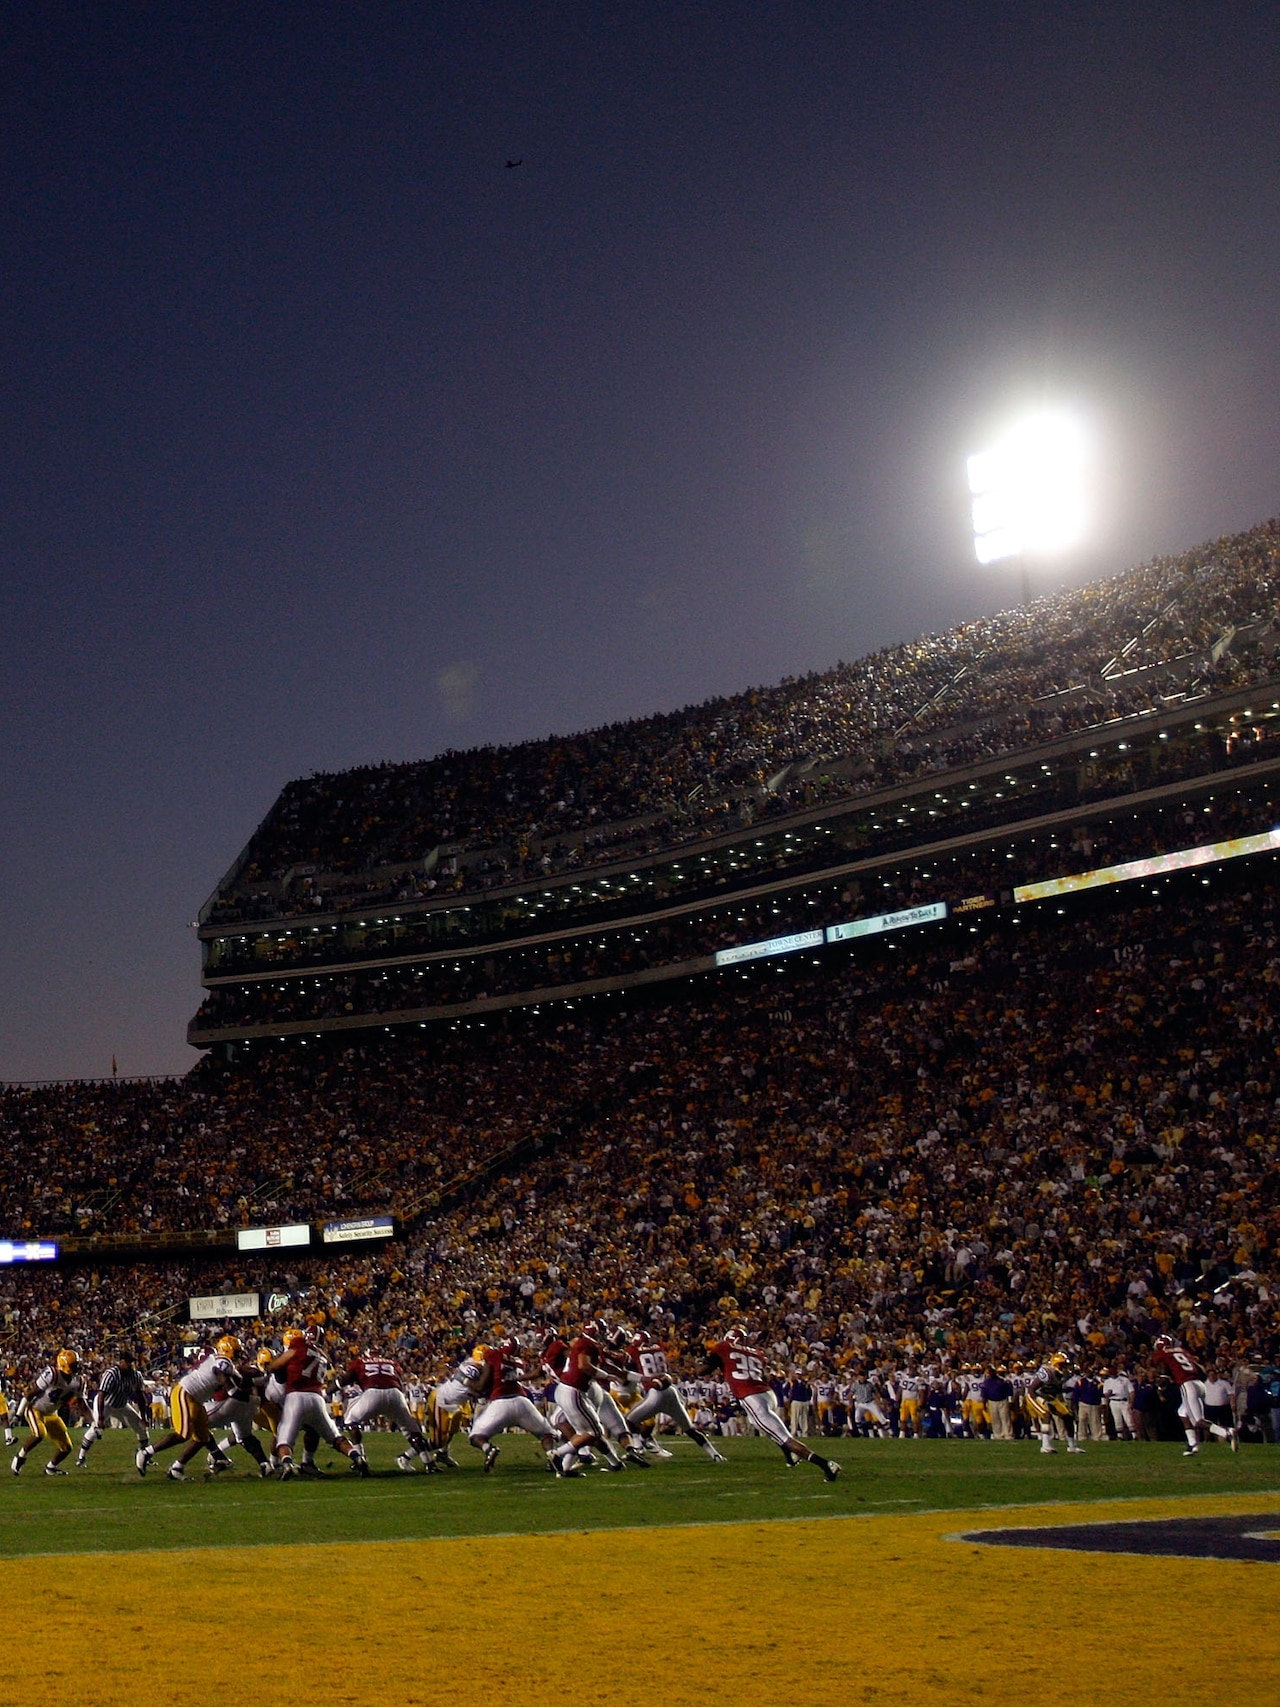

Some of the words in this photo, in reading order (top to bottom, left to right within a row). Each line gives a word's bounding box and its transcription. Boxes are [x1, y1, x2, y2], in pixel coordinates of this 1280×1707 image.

[961, 895, 985, 906] TIGER
[794, 931, 822, 943] CENTER
[639, 1351, 666, 1377] 88
[1172, 1352, 1194, 1371] 9
[903, 1380, 915, 1391] 97
